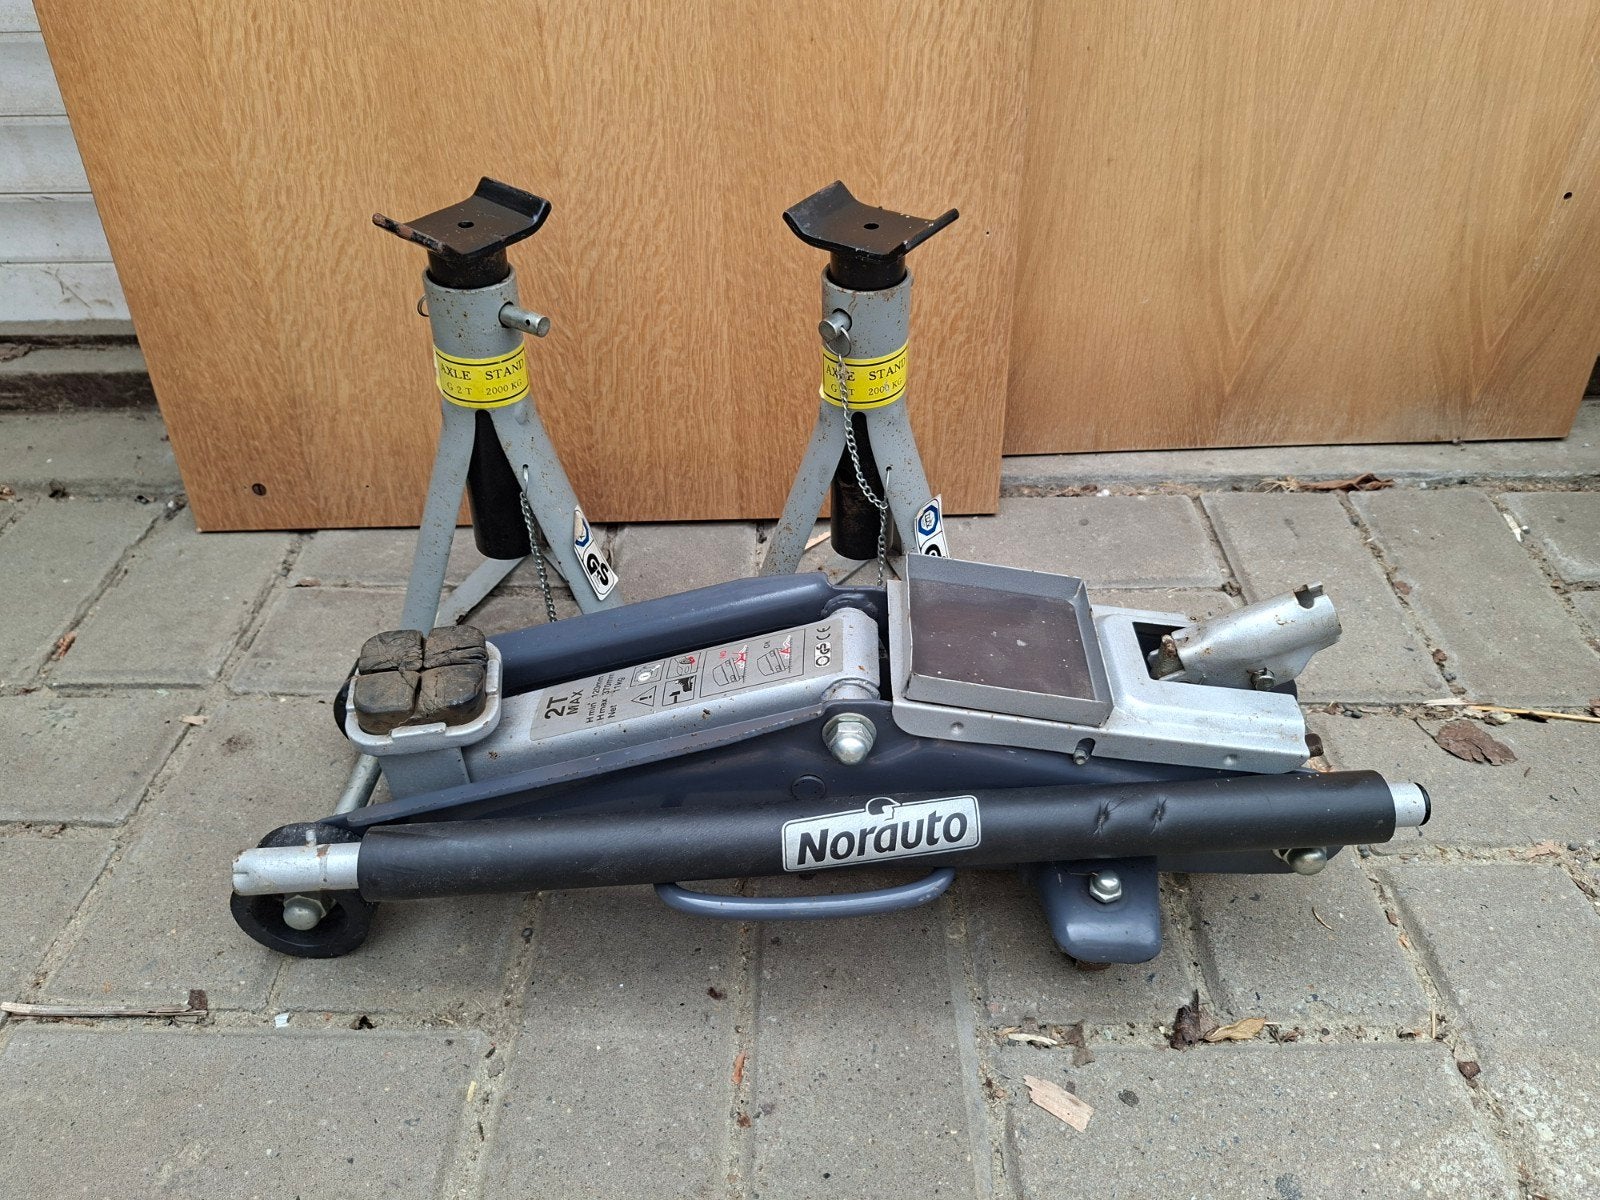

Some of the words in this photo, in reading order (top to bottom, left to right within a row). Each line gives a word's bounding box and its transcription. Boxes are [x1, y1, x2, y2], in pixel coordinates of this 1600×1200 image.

[441, 363, 471, 380] AXLE
[485, 358, 524, 380] STAND
[826, 364, 856, 382] AXE
[868, 358, 906, 381] STAND
[457, 385, 463, 395] 2
[486, 384, 509, 396] 2000
[511, 378, 523, 391] KG
[868, 384, 890, 396] 2000
[892, 378, 902, 389] KG
[544, 696, 569, 720] 2T
[566, 689, 584, 716] MAX
[797, 810, 968, 866] Norauto
